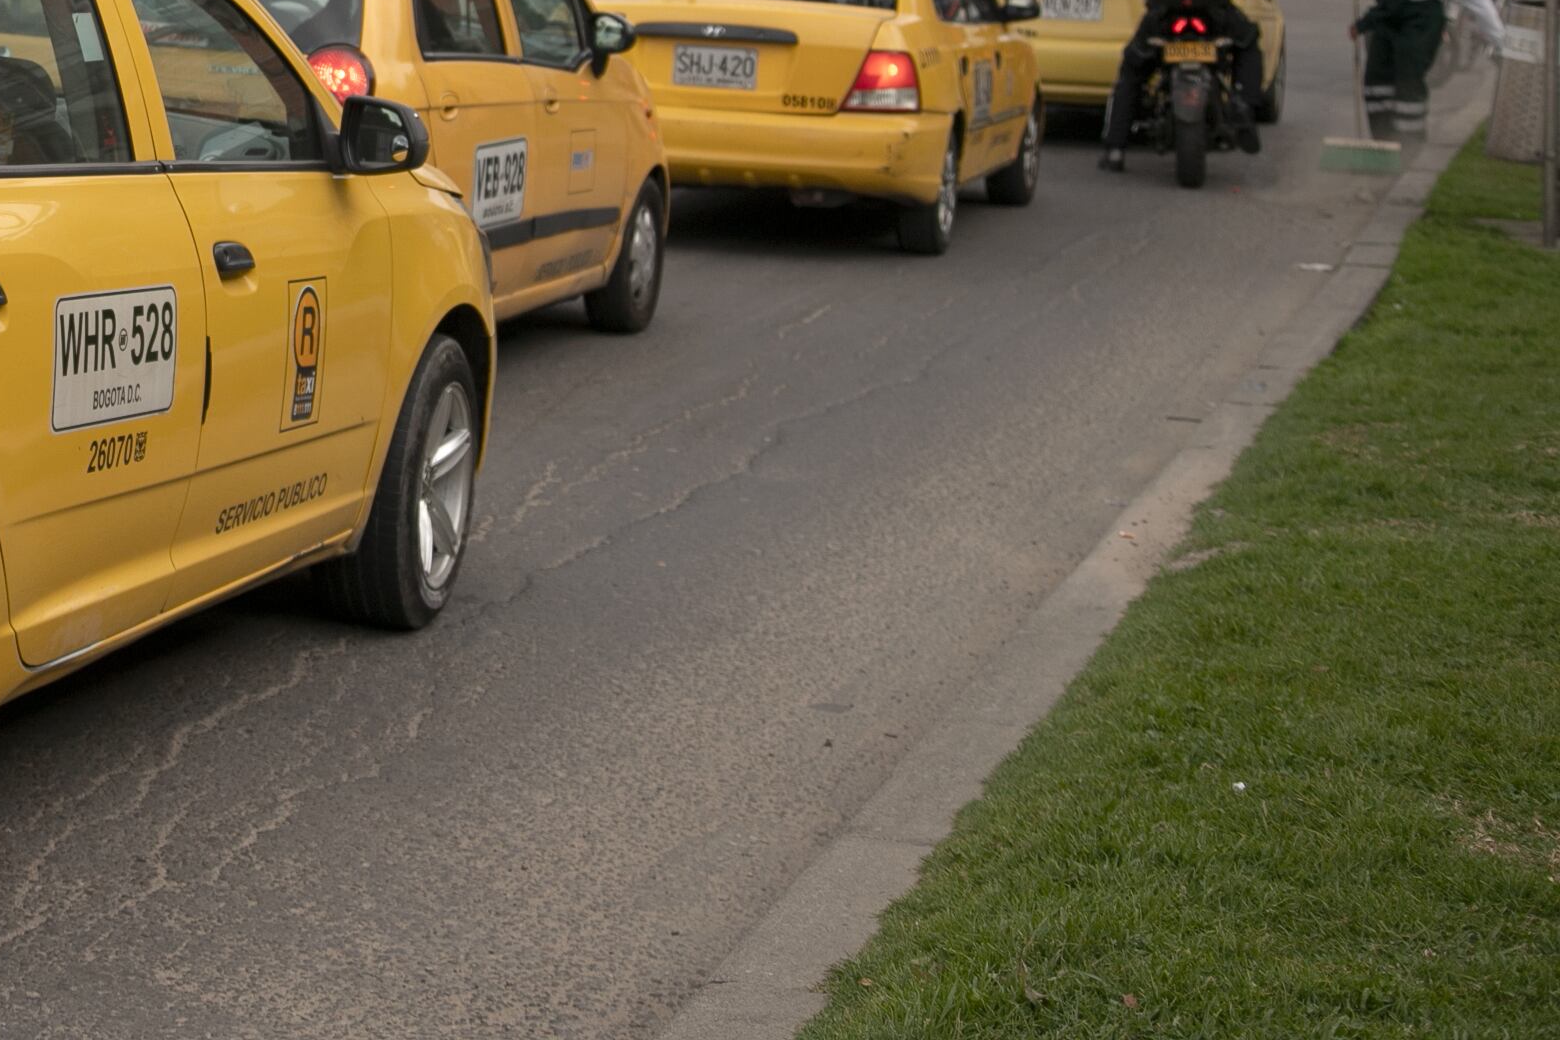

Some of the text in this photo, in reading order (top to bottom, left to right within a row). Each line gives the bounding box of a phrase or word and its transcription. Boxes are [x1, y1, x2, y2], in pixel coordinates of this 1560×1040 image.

[676, 51, 756, 79] SHJ 420
[782, 95, 827, 109] 05810
[476, 156, 500, 202] VEB
[503, 151, 526, 196] 928
[59, 301, 174, 377] WHR 528
[300, 306, 316, 356] R
[92, 383, 142, 410] BOGOTA D.C.
[296, 371, 316, 396] taxi
[86, 433, 134, 474] 26070
[215, 472, 328, 535] SERVICIO PUBLICO
